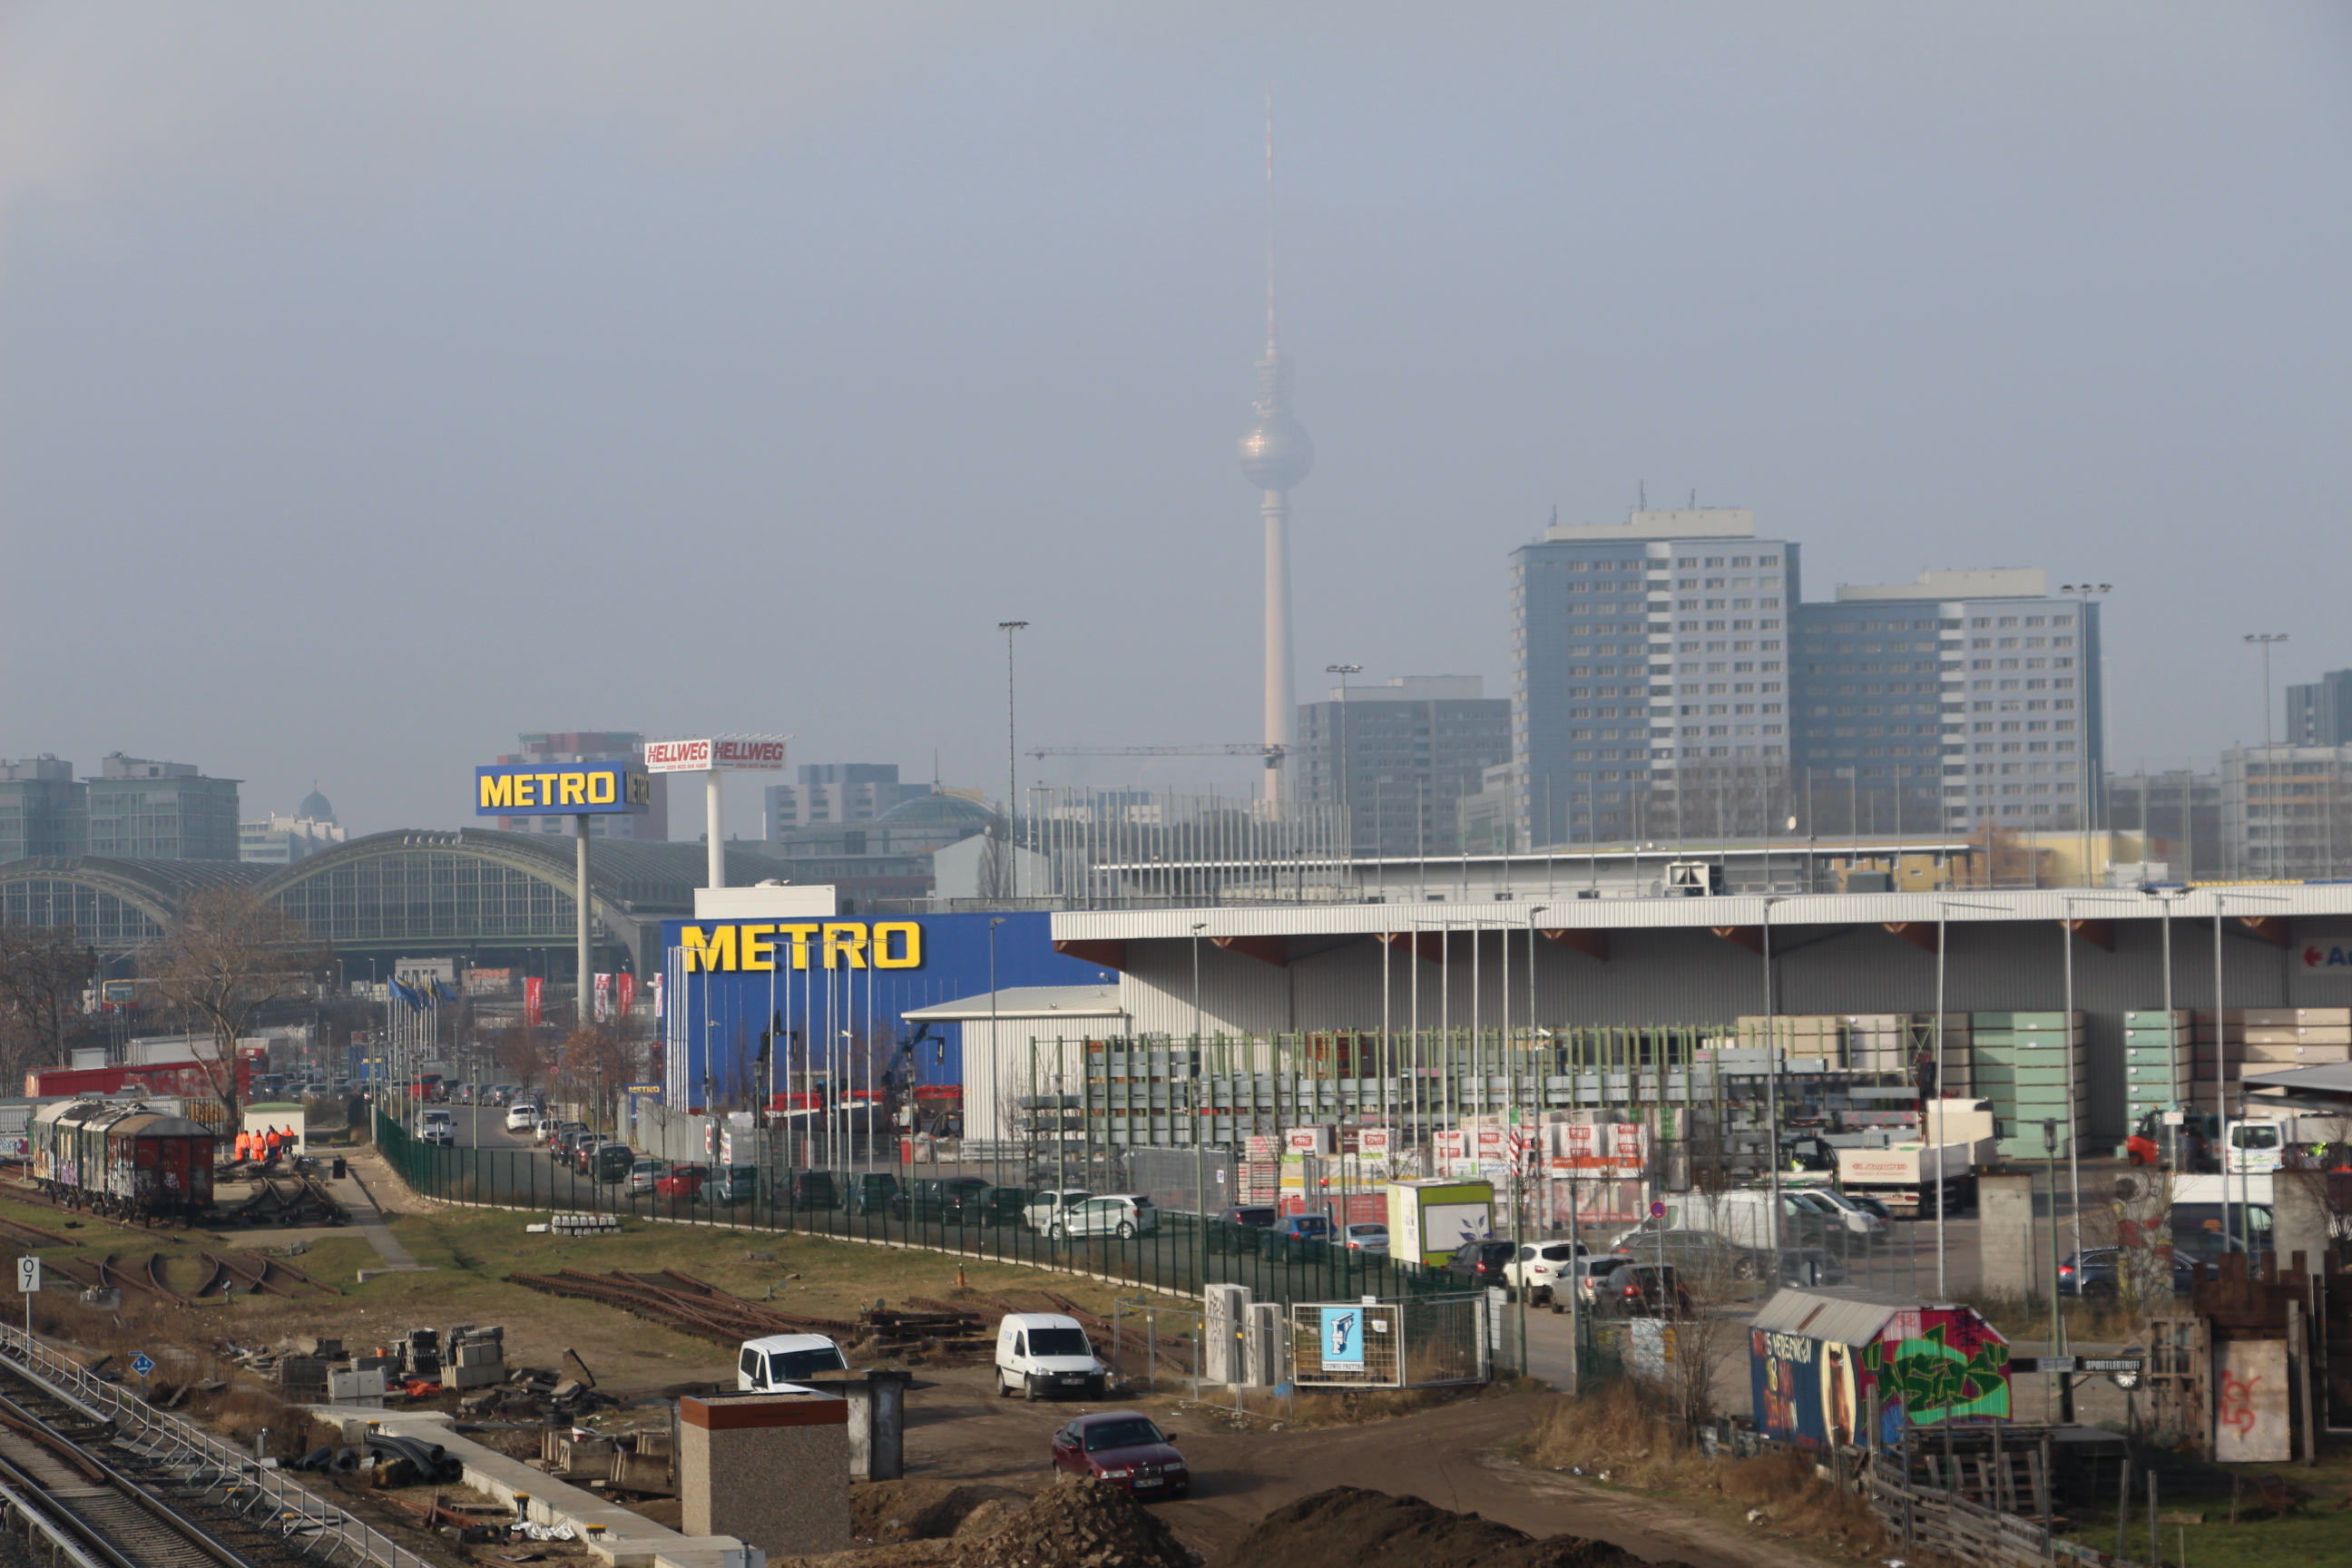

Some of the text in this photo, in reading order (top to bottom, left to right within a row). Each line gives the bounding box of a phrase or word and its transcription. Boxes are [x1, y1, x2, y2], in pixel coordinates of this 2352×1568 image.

[647, 741, 709, 763] HELLWEG
[713, 741, 784, 760] HELLWEG
[480, 771, 615, 807] METRO
[626, 771, 650, 805] METRO
[681, 922, 920, 972] METRO
[24, 1274, 33, 1289] 7
[2086, 1360, 2141, 1370] SPORTLERTREFF
